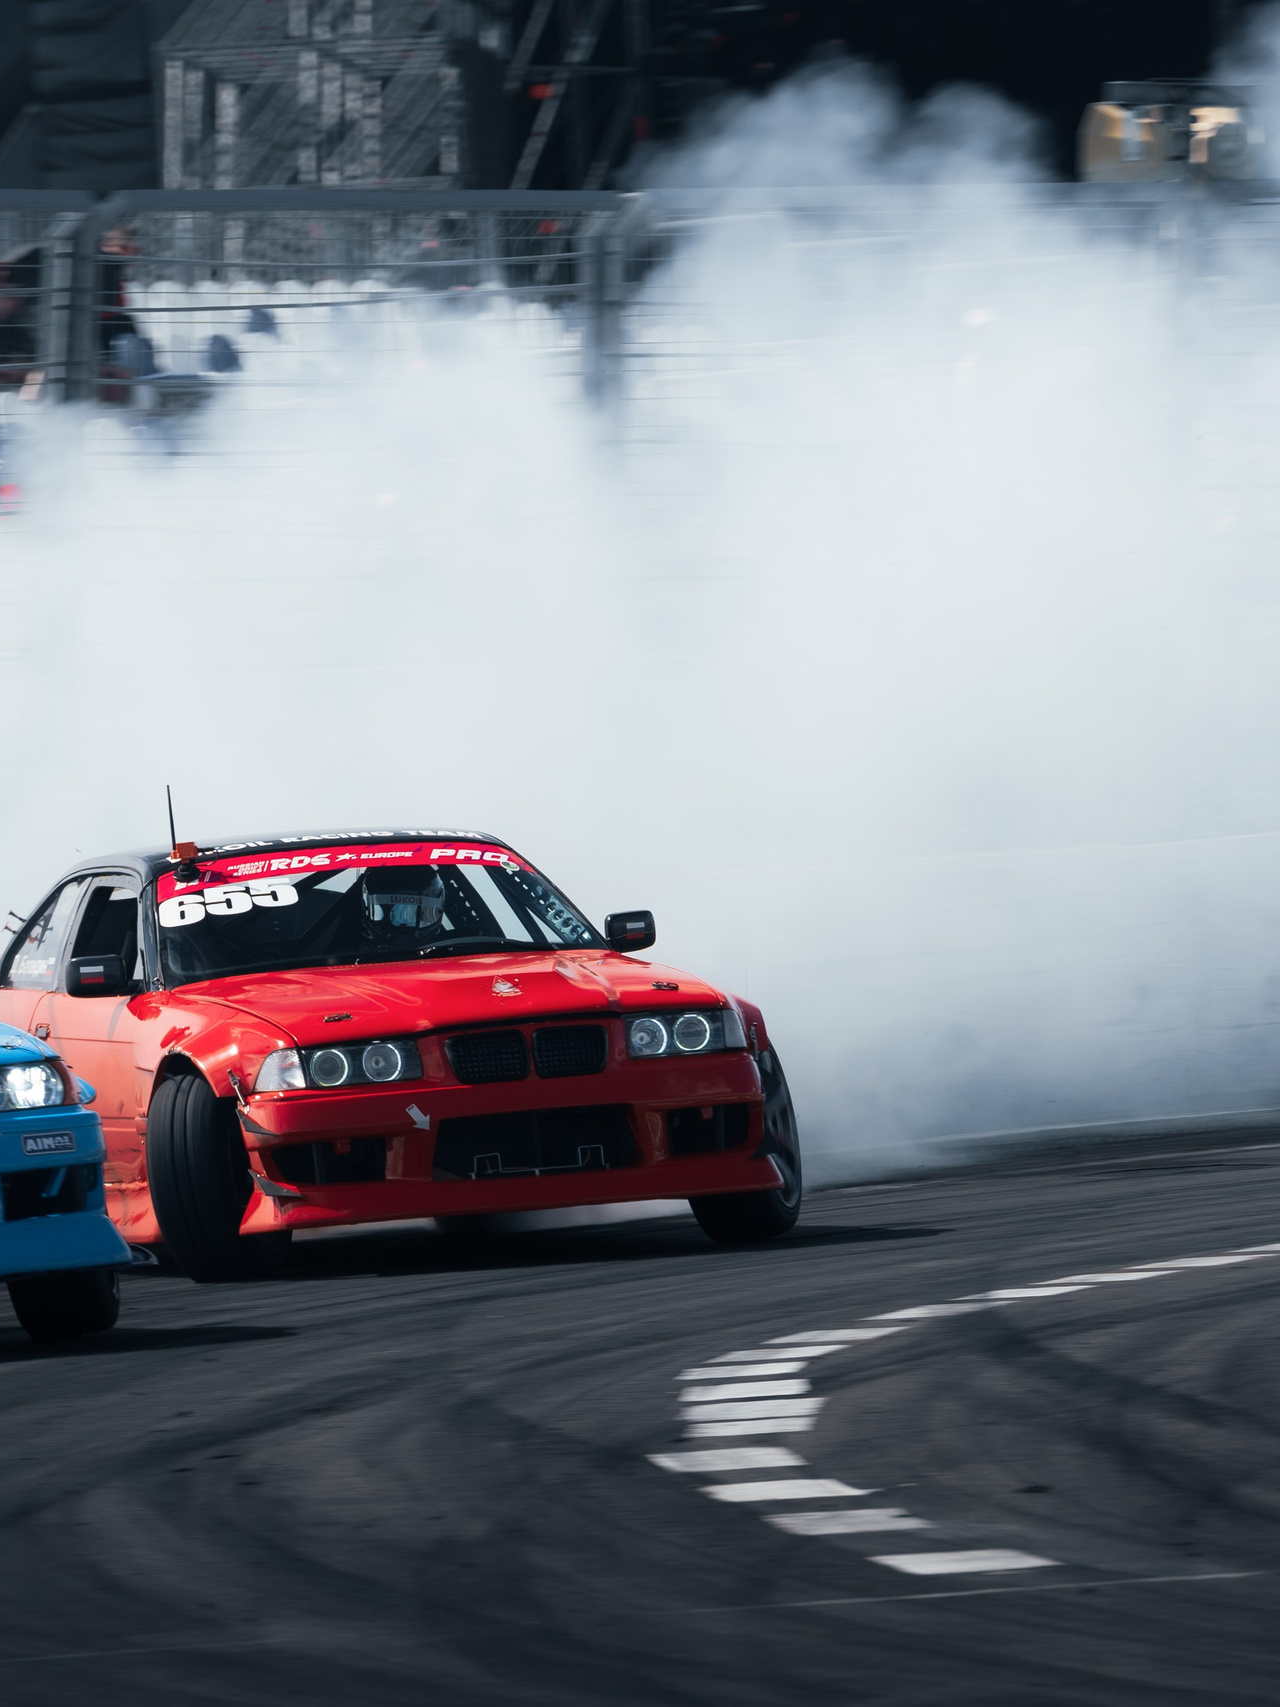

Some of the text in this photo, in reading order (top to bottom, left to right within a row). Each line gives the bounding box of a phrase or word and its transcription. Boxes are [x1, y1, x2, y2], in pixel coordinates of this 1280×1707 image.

[281, 831, 395, 844] RACING
[401, 830, 483, 839] TEAM
[270, 848, 509, 871] RDS EUROPE PRO
[158, 877, 299, 928] 655
[390, 895, 423, 905] LUKOIL
[26, 1135, 73, 1151] AIMOL
